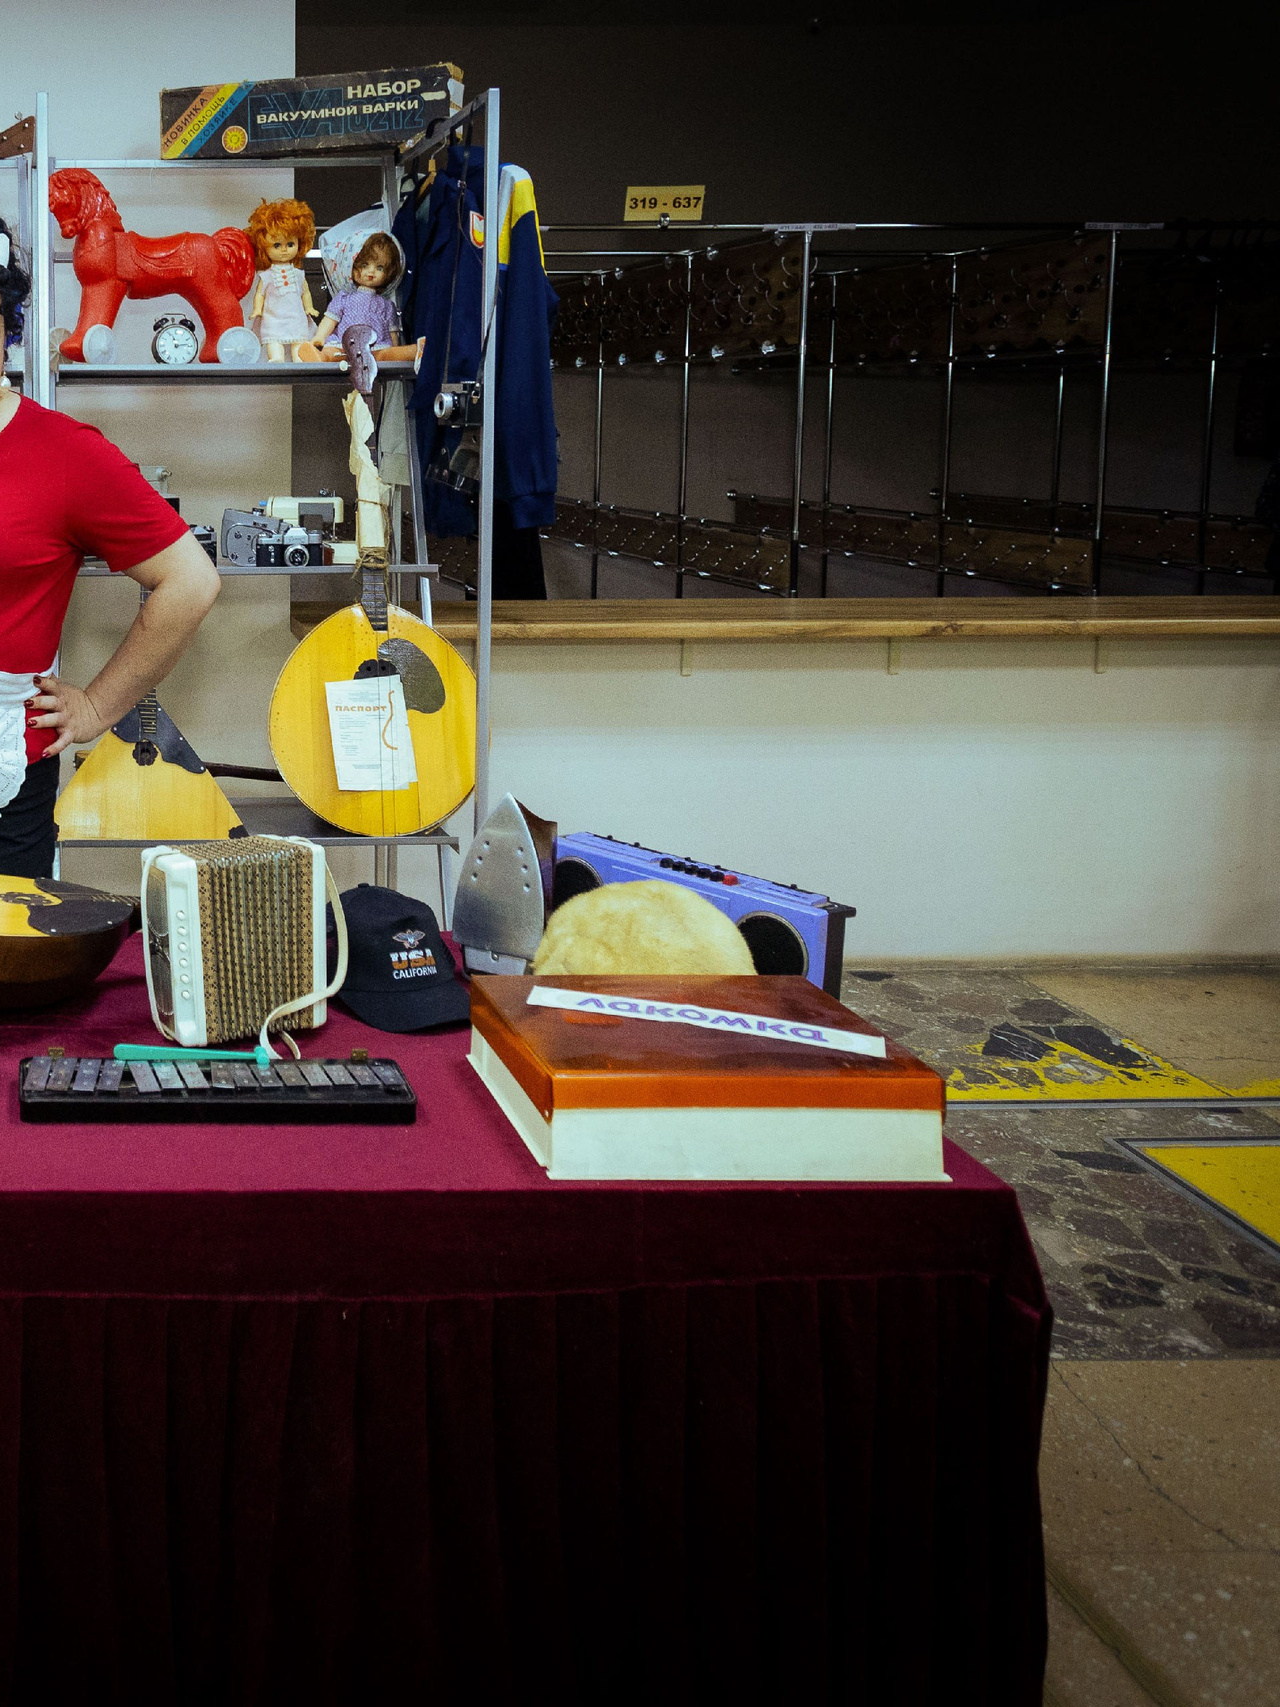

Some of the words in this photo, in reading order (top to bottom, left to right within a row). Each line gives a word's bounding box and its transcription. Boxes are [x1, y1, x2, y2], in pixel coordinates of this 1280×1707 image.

[347, 79, 421, 99] НАБОР
[163, 97, 208, 148] НОВИНКА
[188, 96, 225, 138] ПОМОЩЬ
[198, 98, 238, 143] ХОЗЯЙКЕ
[256, 105, 358, 124] ВАКУУМНОЙ
[362, 100, 419, 115] ВАРКИ
[629, 197, 658, 209] 319
[672, 196, 702, 208] 637
[388, 948, 436, 969] USA
[392, 966, 438, 980] CALIFORNIA
